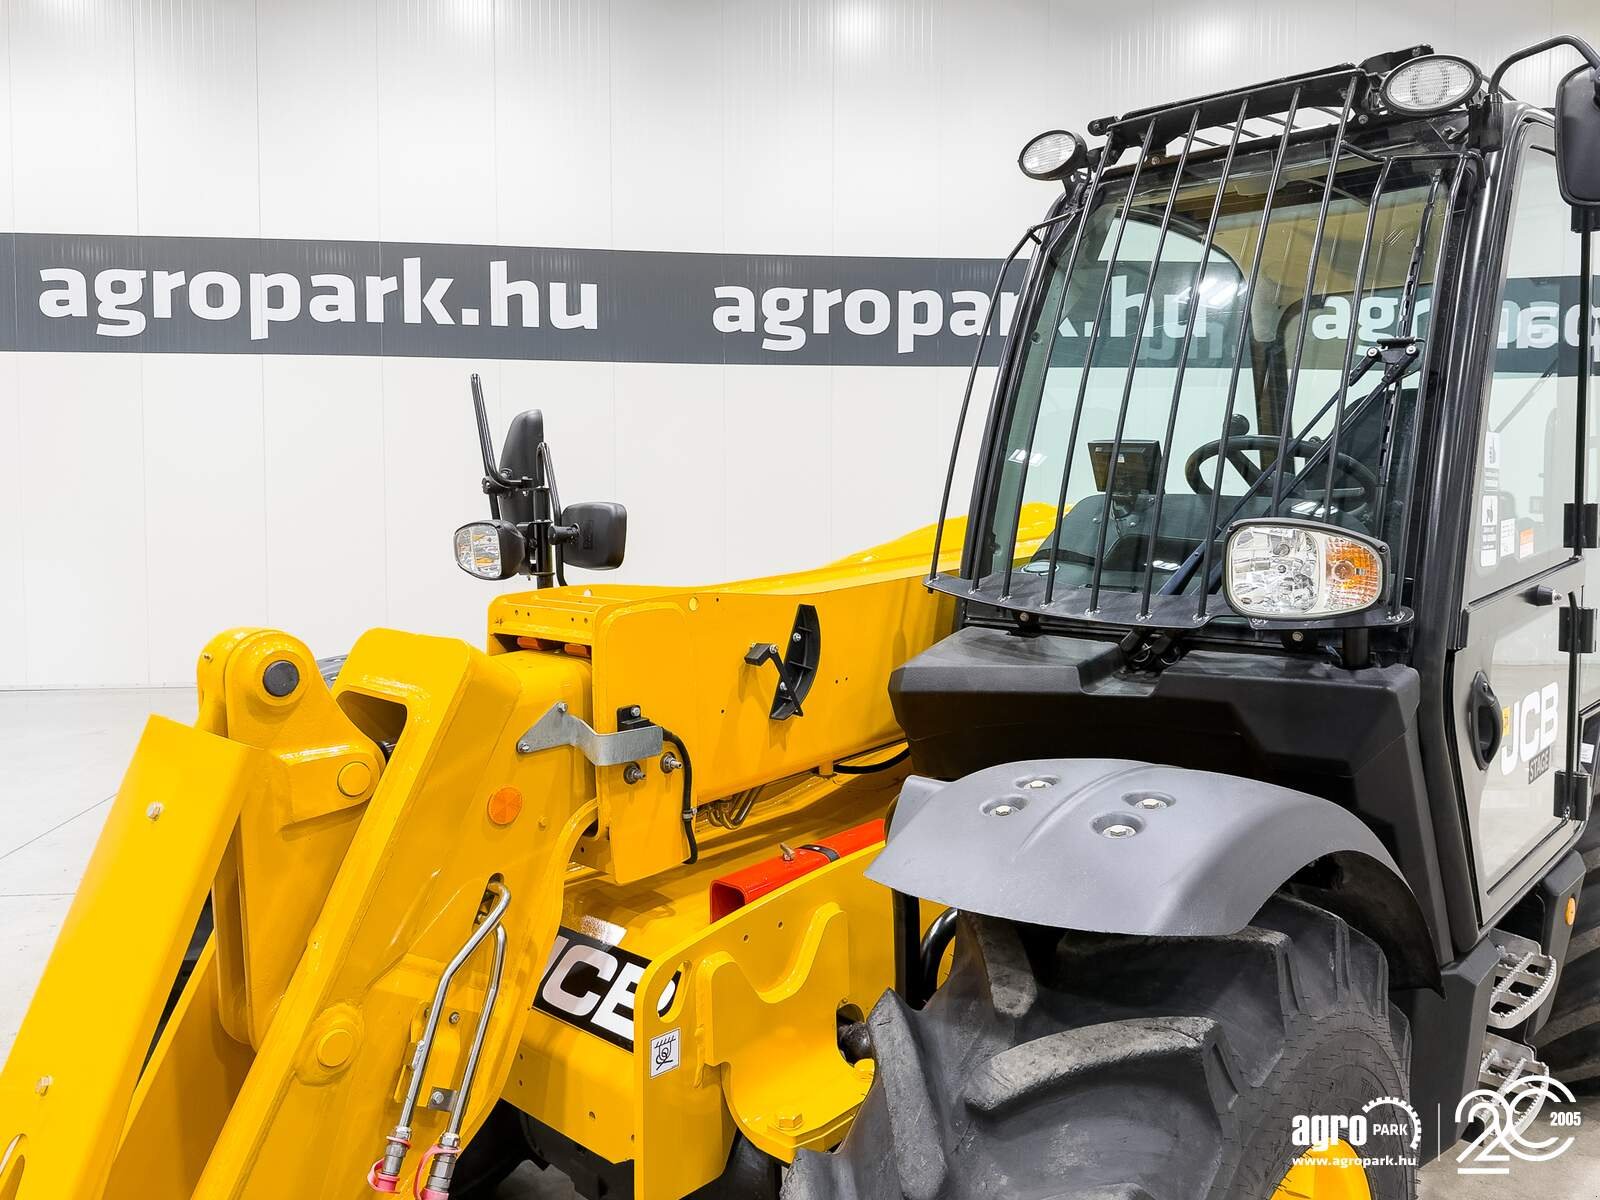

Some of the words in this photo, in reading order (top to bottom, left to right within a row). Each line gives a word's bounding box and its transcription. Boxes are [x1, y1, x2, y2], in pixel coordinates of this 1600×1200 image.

[39, 257, 598, 340] agropark.hu
[712, 275, 1207, 354] agropar.hu
[1501, 682, 1559, 776] JCB
